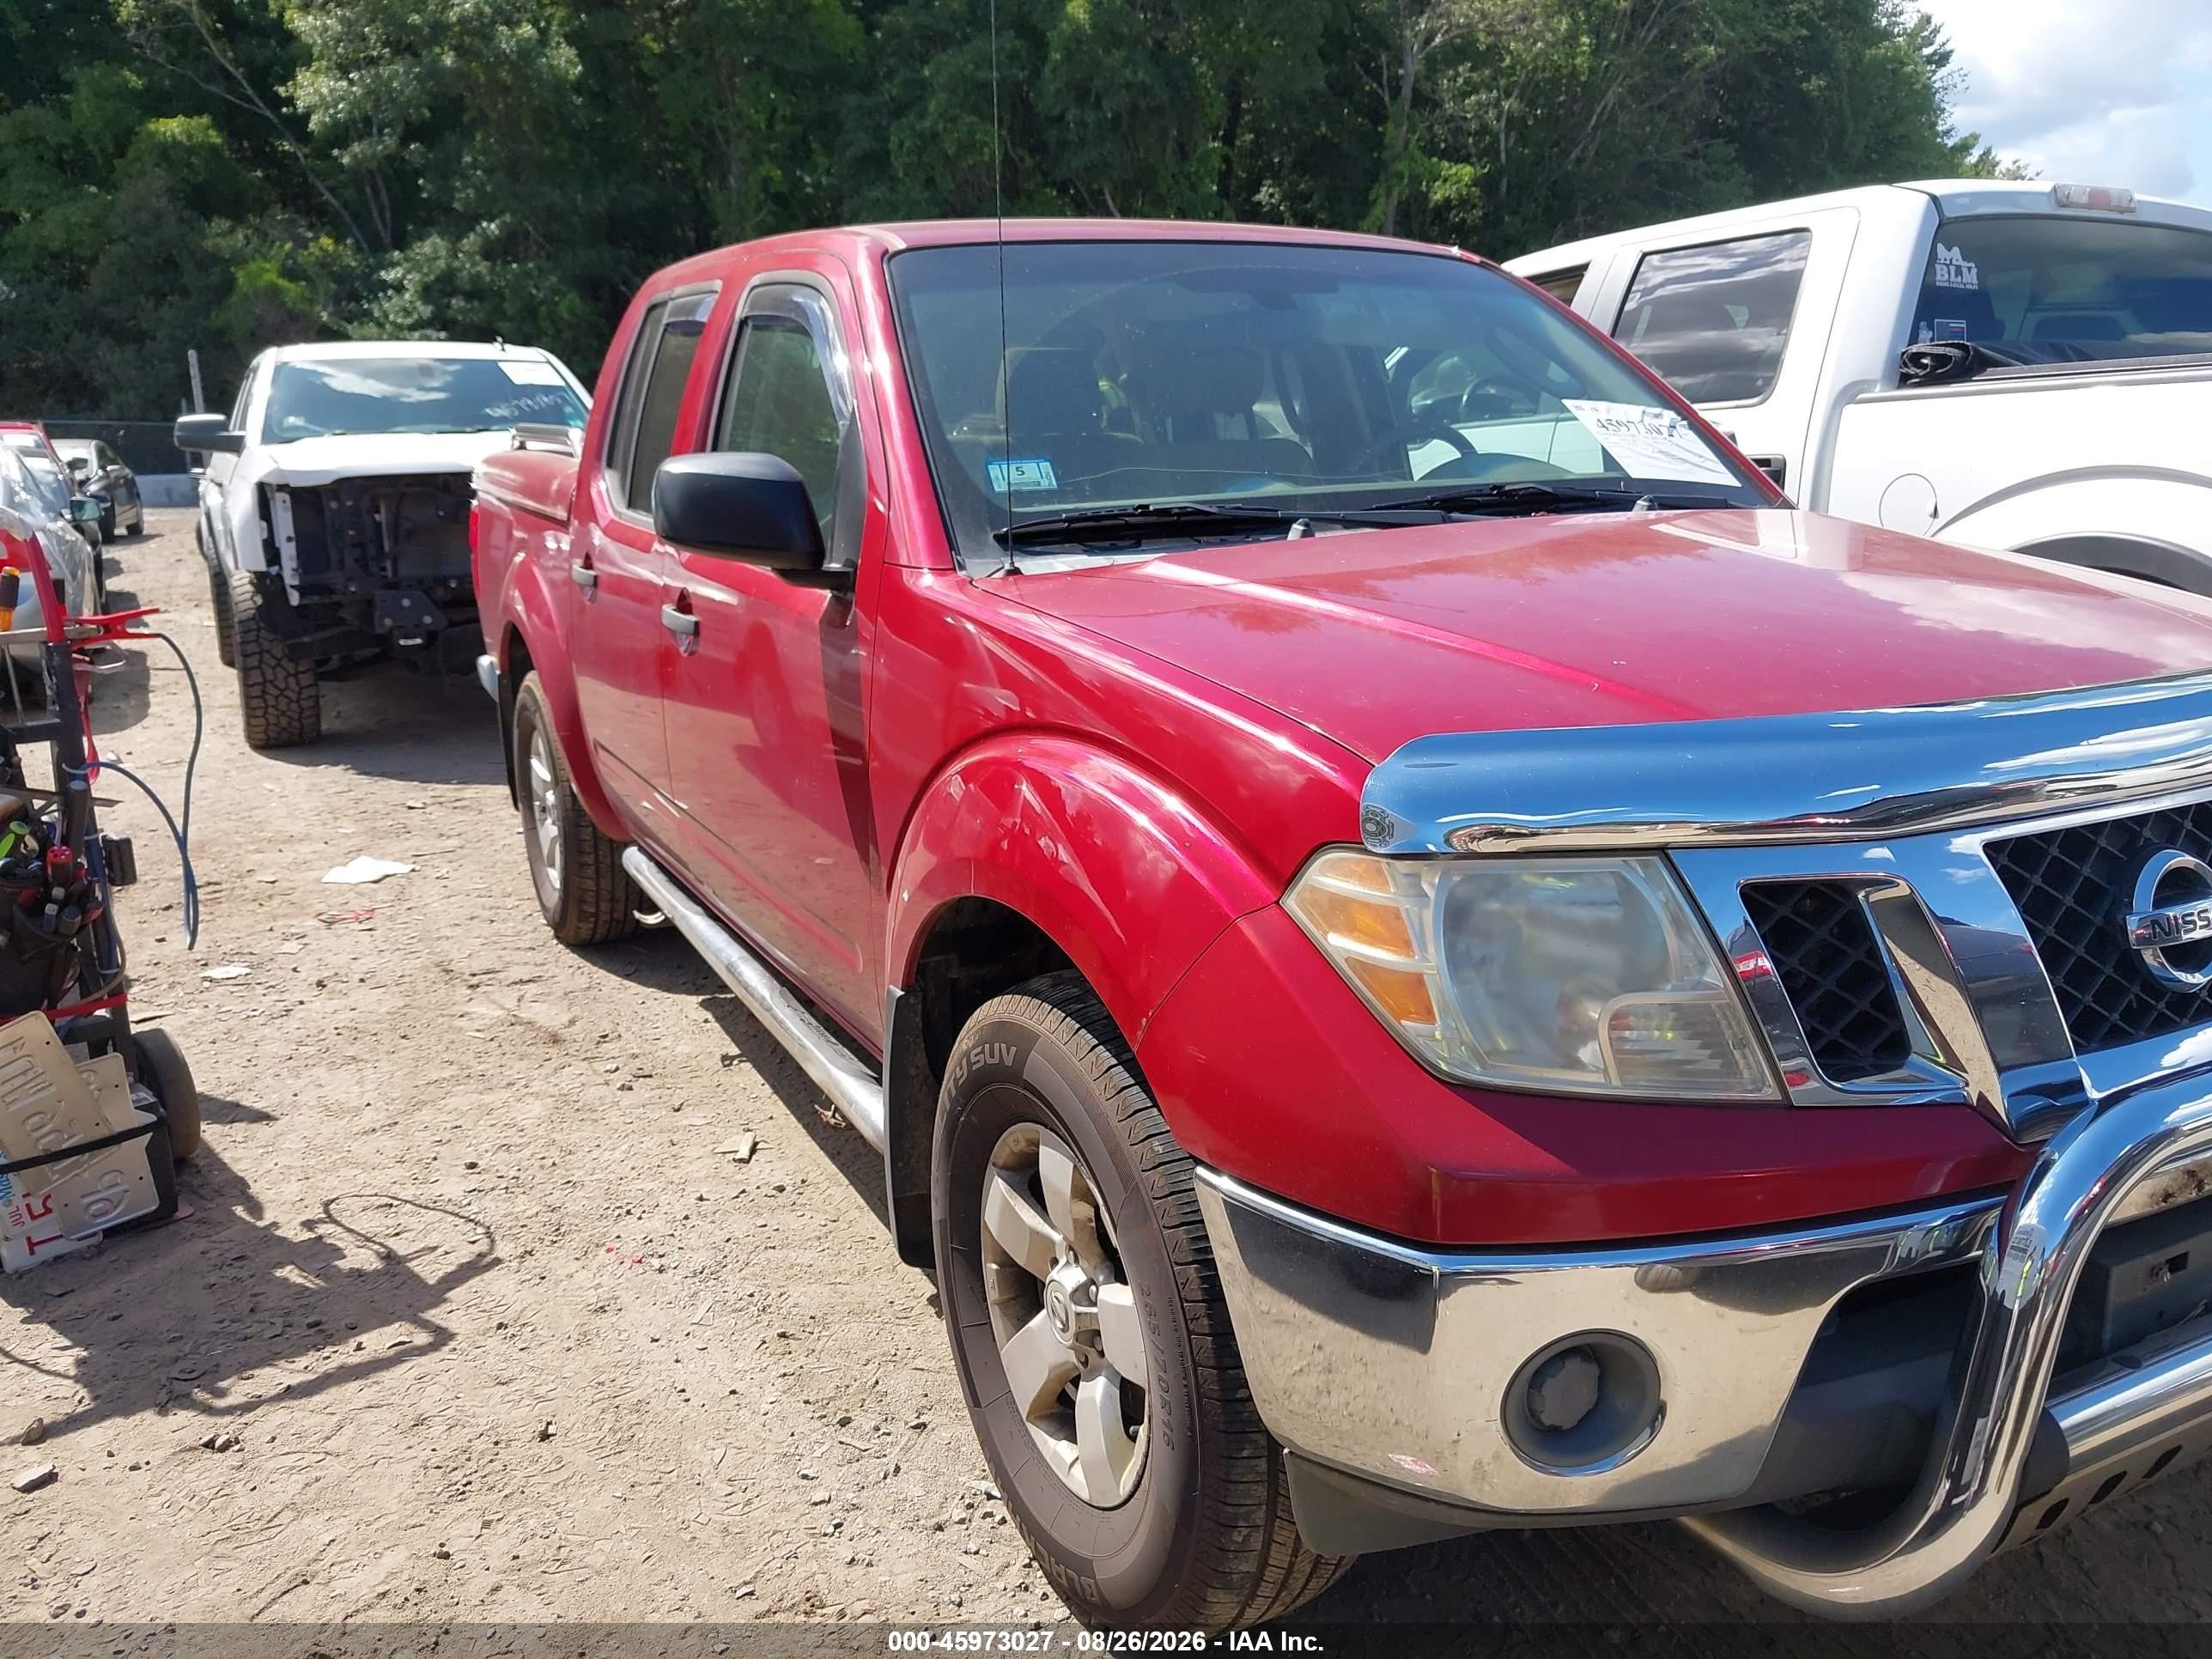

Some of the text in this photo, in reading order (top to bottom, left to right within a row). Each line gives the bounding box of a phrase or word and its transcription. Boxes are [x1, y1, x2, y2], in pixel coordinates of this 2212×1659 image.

[1935, 263, 1978, 284] BLM
[1015, 466, 1025, 477] 5
[2149, 908, 2211, 941] NISS
[969, 1042, 1018, 1073] SUV
[8, 1204, 25, 1228] JUL
